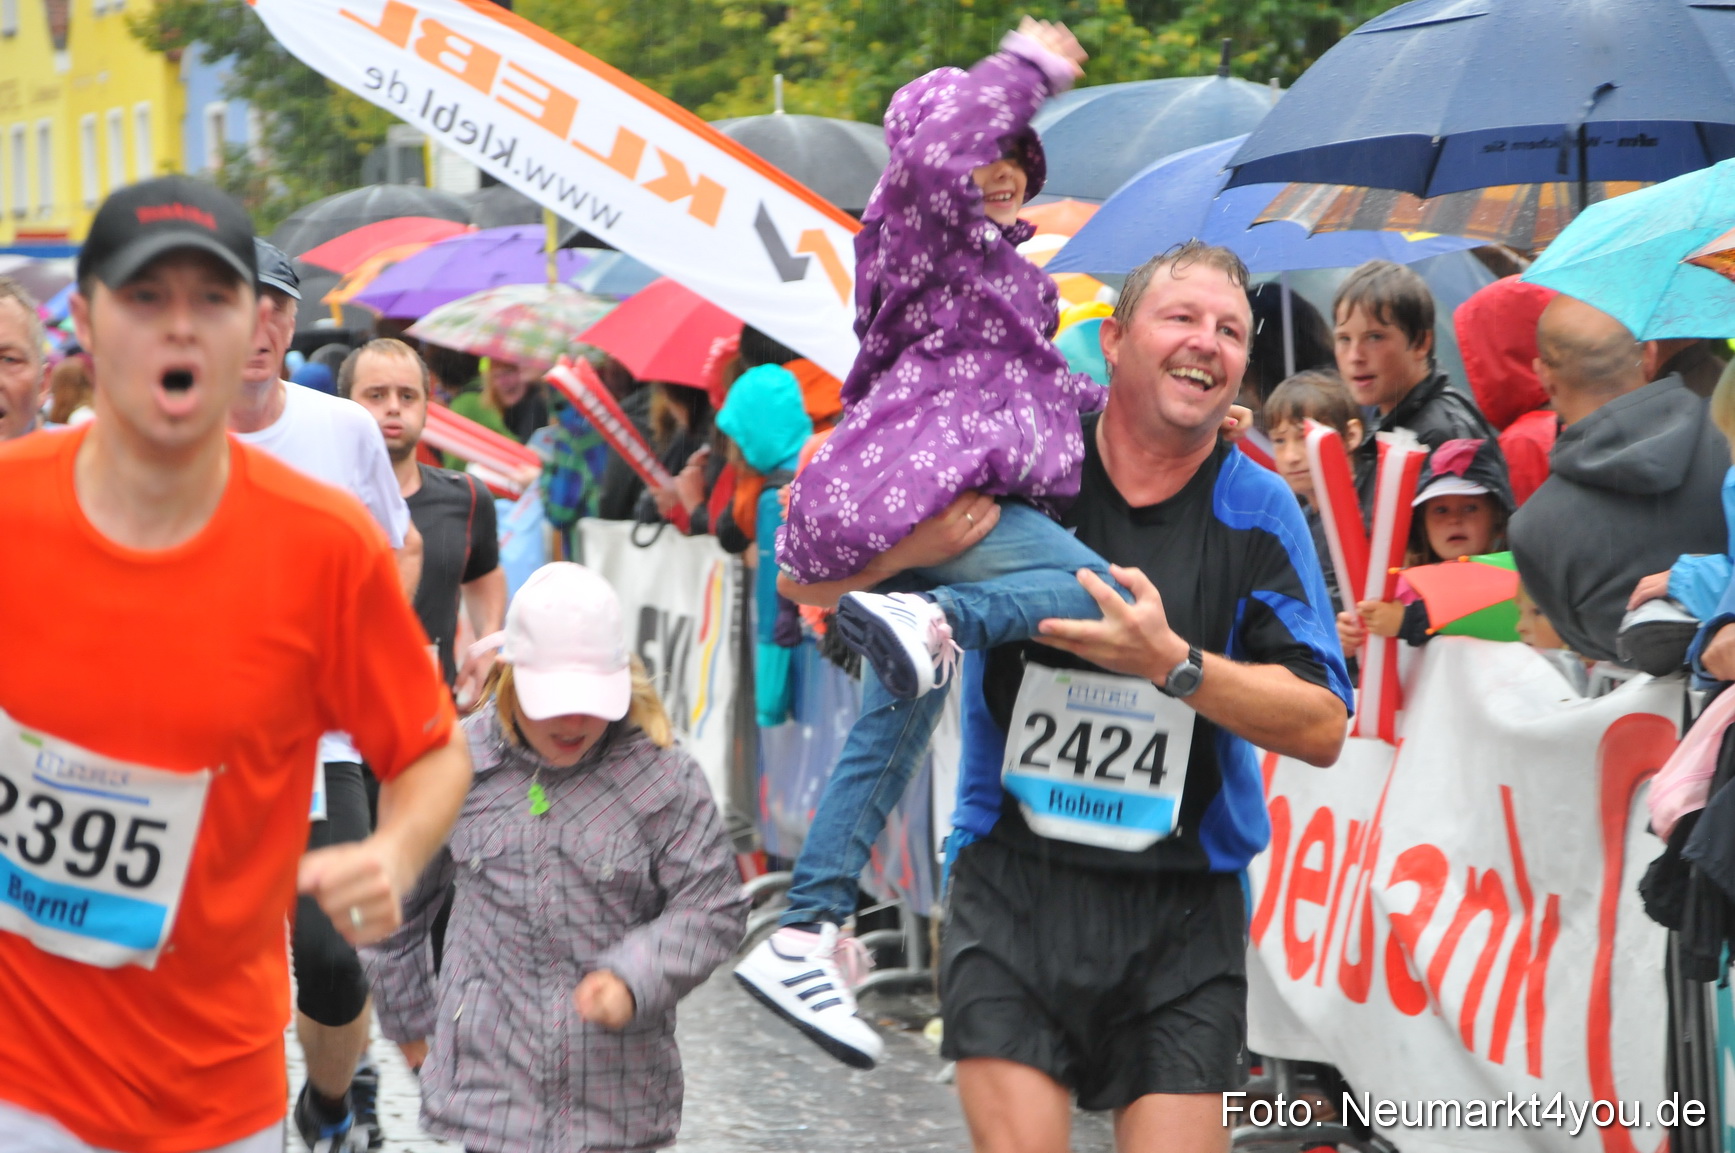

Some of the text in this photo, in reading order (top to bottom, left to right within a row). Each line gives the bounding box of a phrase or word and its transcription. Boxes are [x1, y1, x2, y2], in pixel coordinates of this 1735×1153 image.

[1019, 710, 1169, 789] 2424
[1048, 786, 1124, 823] Robert
[7, 873, 90, 928] Bernd
